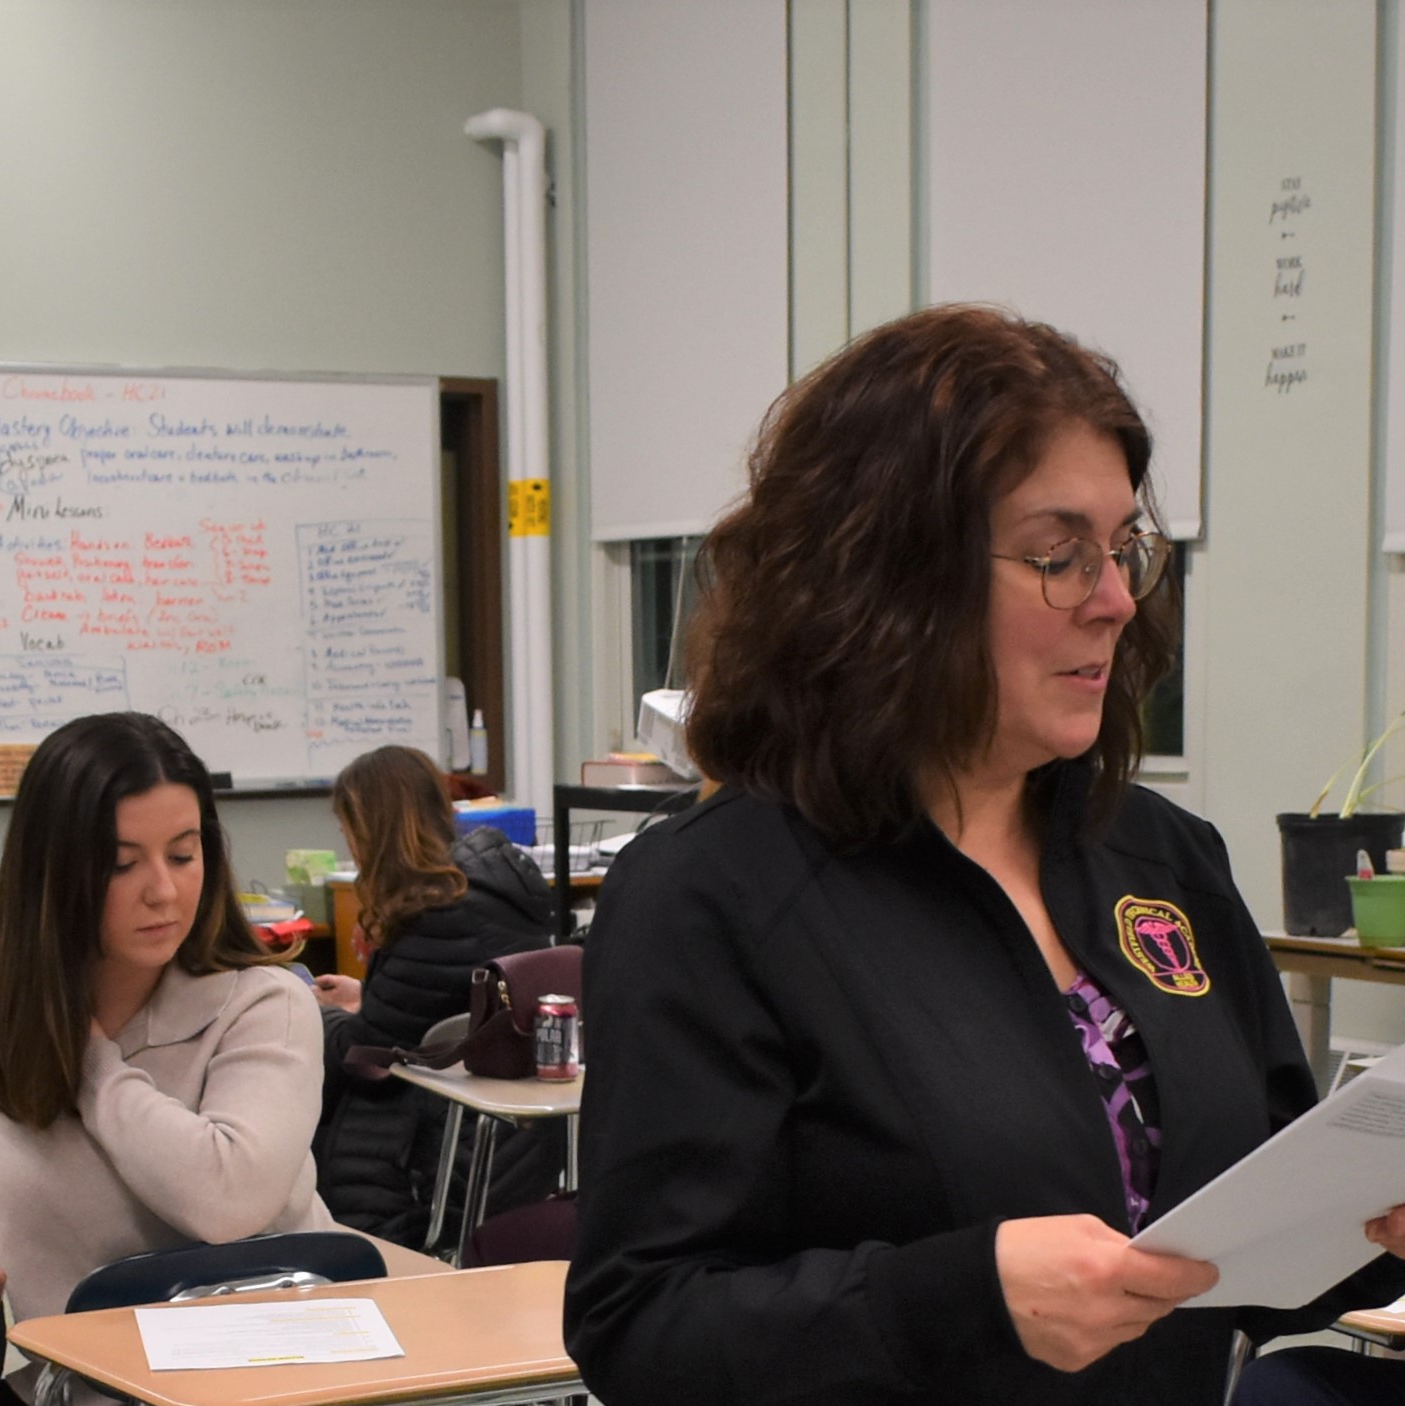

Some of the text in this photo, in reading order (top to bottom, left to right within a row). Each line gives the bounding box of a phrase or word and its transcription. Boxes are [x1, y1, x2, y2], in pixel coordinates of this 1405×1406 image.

[148, 412, 218, 438] Students
[226, 418, 252, 437] will
[6, 494, 50, 521] Mini
[19, 630, 65, 652] Vocab
